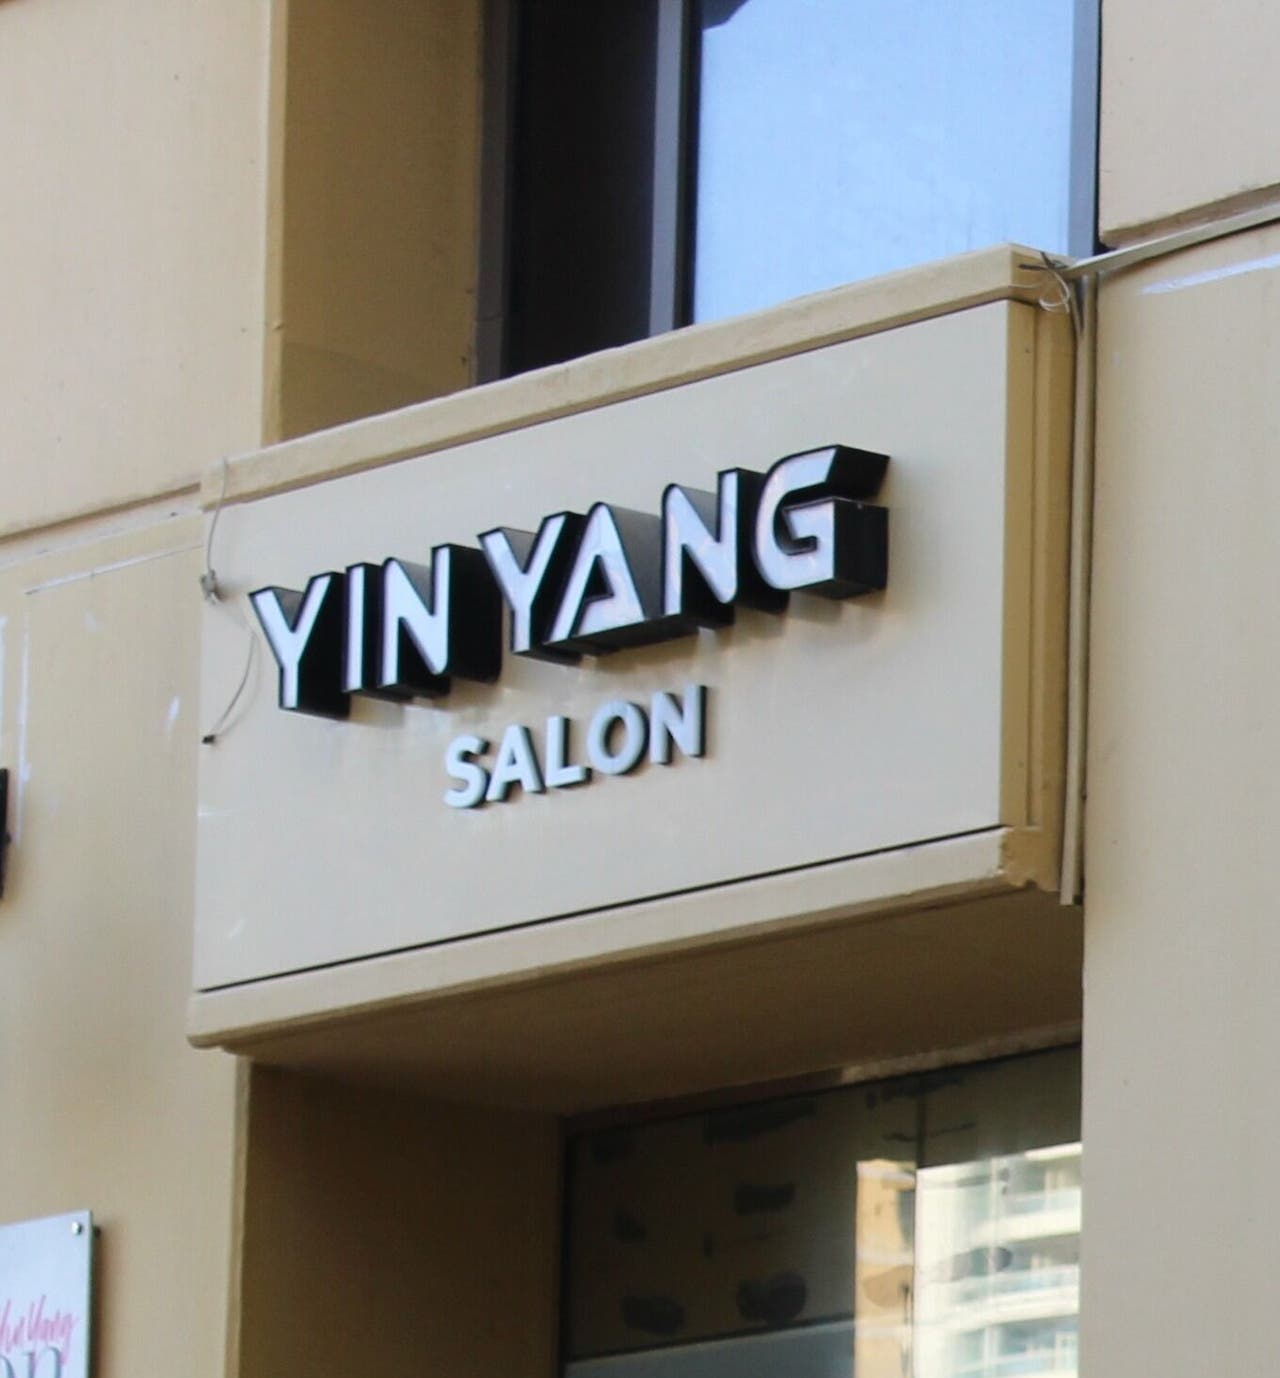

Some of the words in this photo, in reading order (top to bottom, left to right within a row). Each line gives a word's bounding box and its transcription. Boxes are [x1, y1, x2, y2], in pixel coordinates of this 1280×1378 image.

[249, 543, 499, 718] YIN
[477, 444, 891, 664] YANG
[442, 683, 708, 809] SALON
